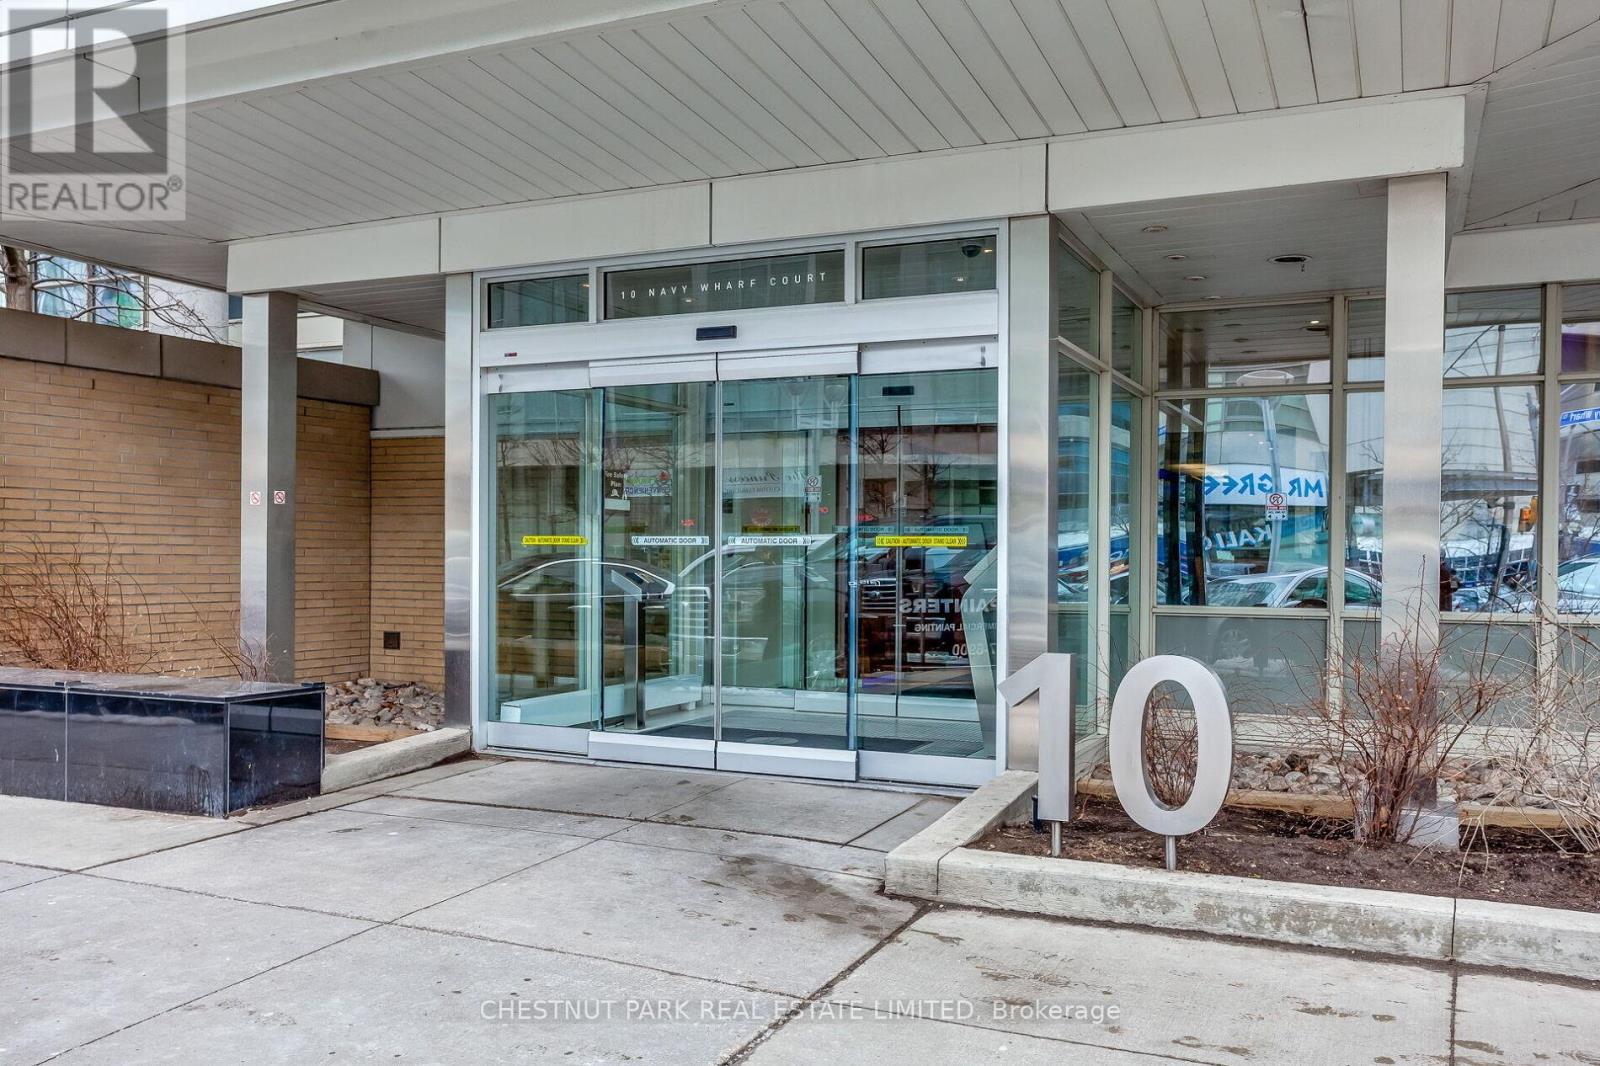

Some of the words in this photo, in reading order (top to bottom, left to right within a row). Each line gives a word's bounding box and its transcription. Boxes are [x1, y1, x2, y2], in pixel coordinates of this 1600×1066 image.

[621, 289, 637, 300] 10
[648, 284, 688, 297] NAVY
[700, 278, 757, 292] WHARF
[769, 272, 827, 287] COURT
[643, 537, 678, 545] AUTOMATIC
[679, 537, 697, 545] DOOR
[741, 537, 777, 545] AUTOMATIC
[778, 537, 798, 545] DOOR
[997, 652, 1233, 836] 10
